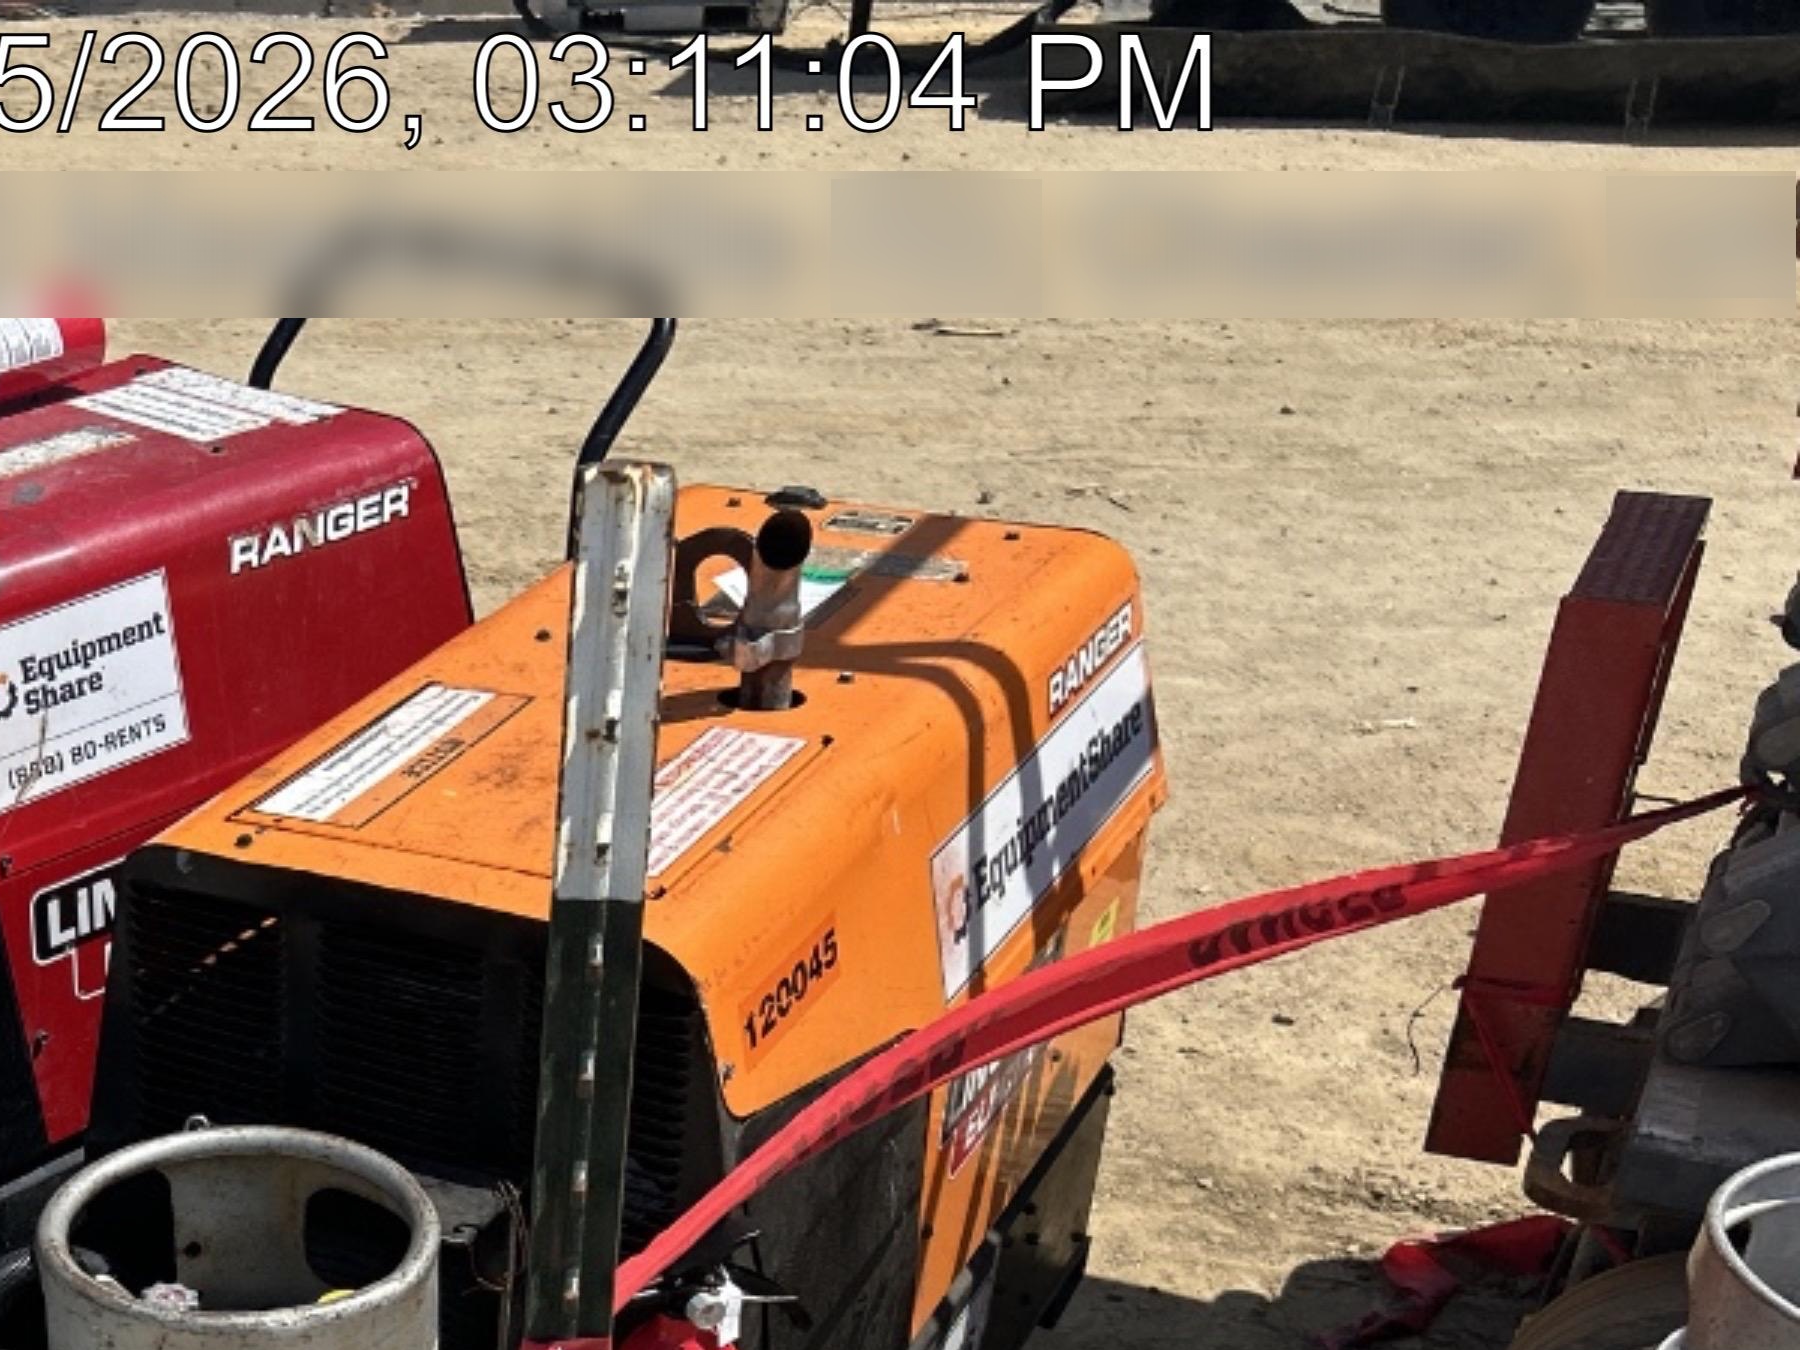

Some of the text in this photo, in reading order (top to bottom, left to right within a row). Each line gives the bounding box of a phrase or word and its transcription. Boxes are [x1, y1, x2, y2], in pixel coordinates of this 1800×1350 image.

[229, 482, 411, 575] RANGER
[17, 610, 167, 684] Equipment
[22, 668, 104, 717] Share
[1049, 601, 1134, 716] RANGER
[70, 713, 167, 766] 80-RENTS
[970, 699, 1145, 911] EquipmentShare
[743, 927, 840, 1050] 120045
